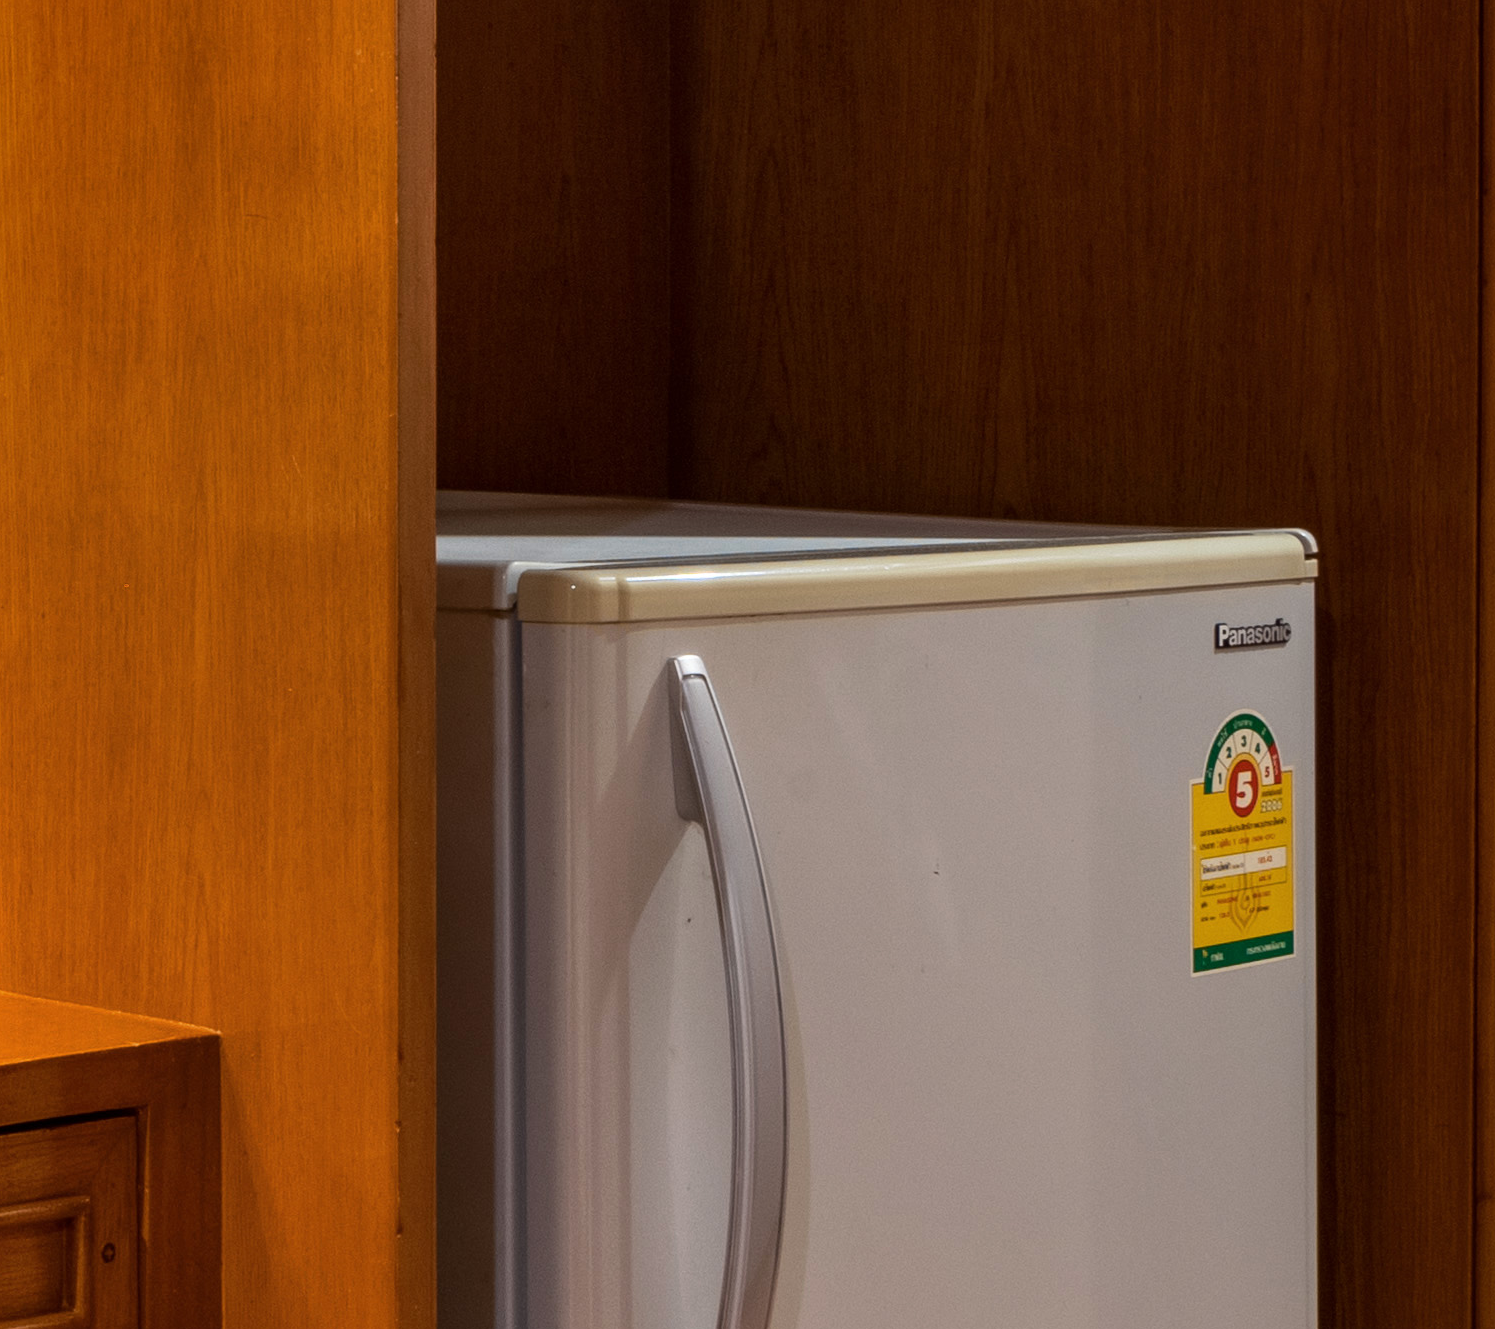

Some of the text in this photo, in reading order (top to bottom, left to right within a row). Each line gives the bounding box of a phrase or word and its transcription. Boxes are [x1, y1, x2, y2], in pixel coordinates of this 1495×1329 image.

[1219, 619, 1291, 647] Panasonic
[1226, 747, 1232, 758] 2
[1241, 735, 1247, 747] 3
[1255, 743, 1261, 754] 4
[1264, 766, 1270, 777] 5
[1235, 771, 1253, 809] 5
